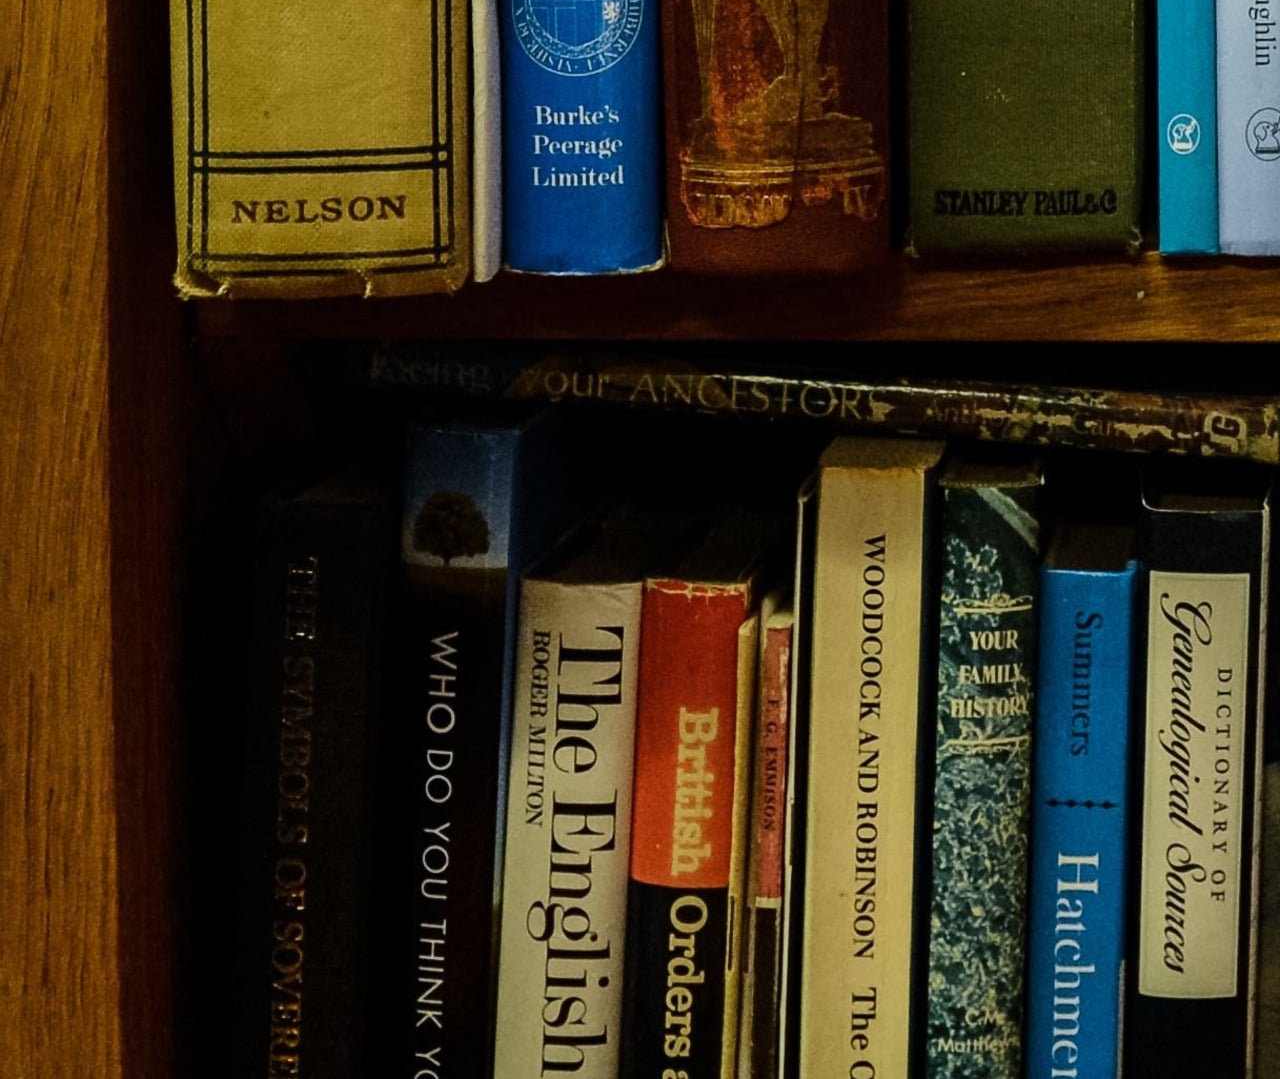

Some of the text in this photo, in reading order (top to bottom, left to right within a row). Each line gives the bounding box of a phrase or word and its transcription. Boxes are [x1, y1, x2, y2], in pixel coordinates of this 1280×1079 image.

[531, 164, 625, 187] Limited
[533, 134, 624, 158] Peerage
[534, 104, 621, 126] Burke's
[231, 194, 409, 224] NELSON
[934, 190, 1029, 217] STANLEY
[958, 662, 1024, 685] FAMILY
[969, 628, 1019, 651] YOUR
[1068, 611, 1101, 757] Summers
[525, 630, 552, 828] ROGER MILTON
[849, 533, 886, 1051] WOODCOCK AND ROBINSON The
[1159, 591, 1214, 975] Genealogical Sources
[1209, 668, 1234, 903] DICTIONARY OF
[415, 630, 458, 1029] WHO DO YOU THINK
[523, 626, 625, 1079] The English
[662, 706, 719, 1059] British Orders
